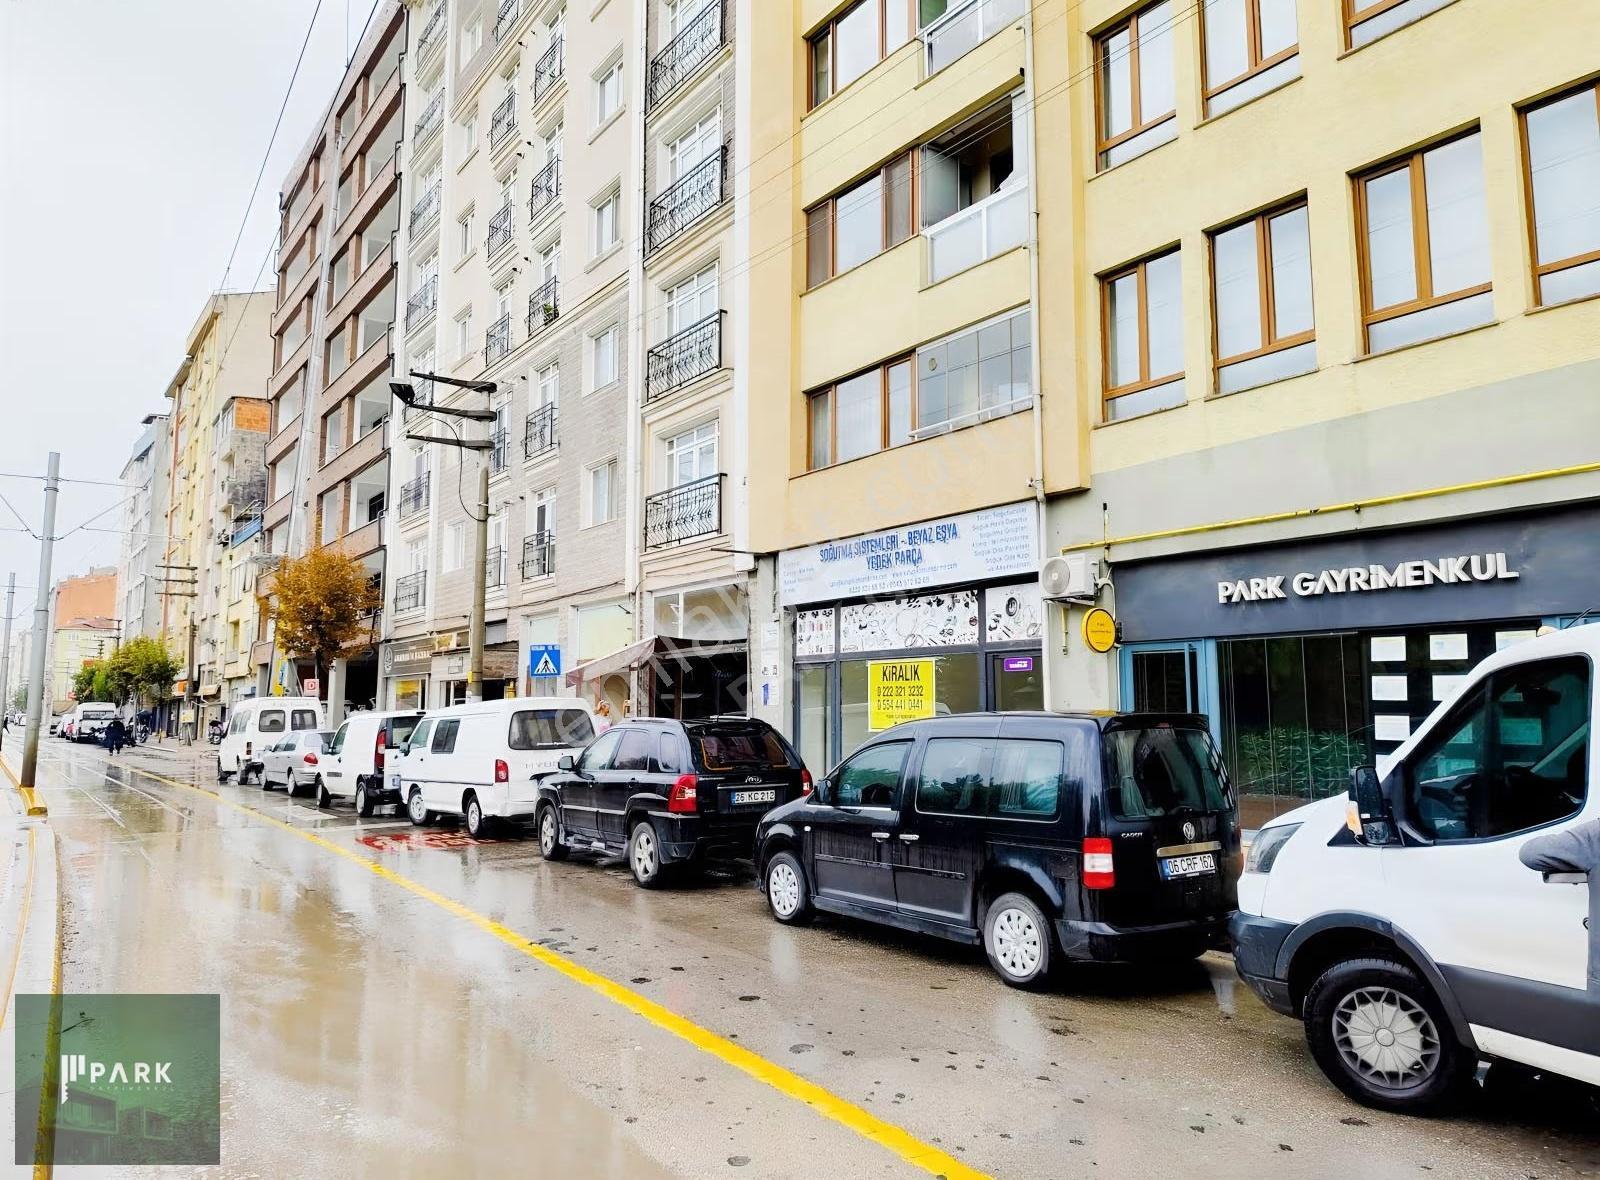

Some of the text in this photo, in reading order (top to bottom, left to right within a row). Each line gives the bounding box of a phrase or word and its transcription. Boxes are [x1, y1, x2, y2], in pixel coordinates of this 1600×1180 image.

[819, 544, 853, 563] SOĞUTMA
[853, 531, 899, 558] SİSTEMLERİ
[907, 527, 934, 546] BEYAZ
[935, 522, 959, 543] EŞYA
[866, 547, 923, 571] YEDEK PARÇA
[1218, 575, 1288, 604] PARK
[882, 686, 893, 697] 222
[895, 686, 906, 697] 321
[908, 685, 924, 697] 3232
[1168, 855, 1214, 874] 06 CRF 162
